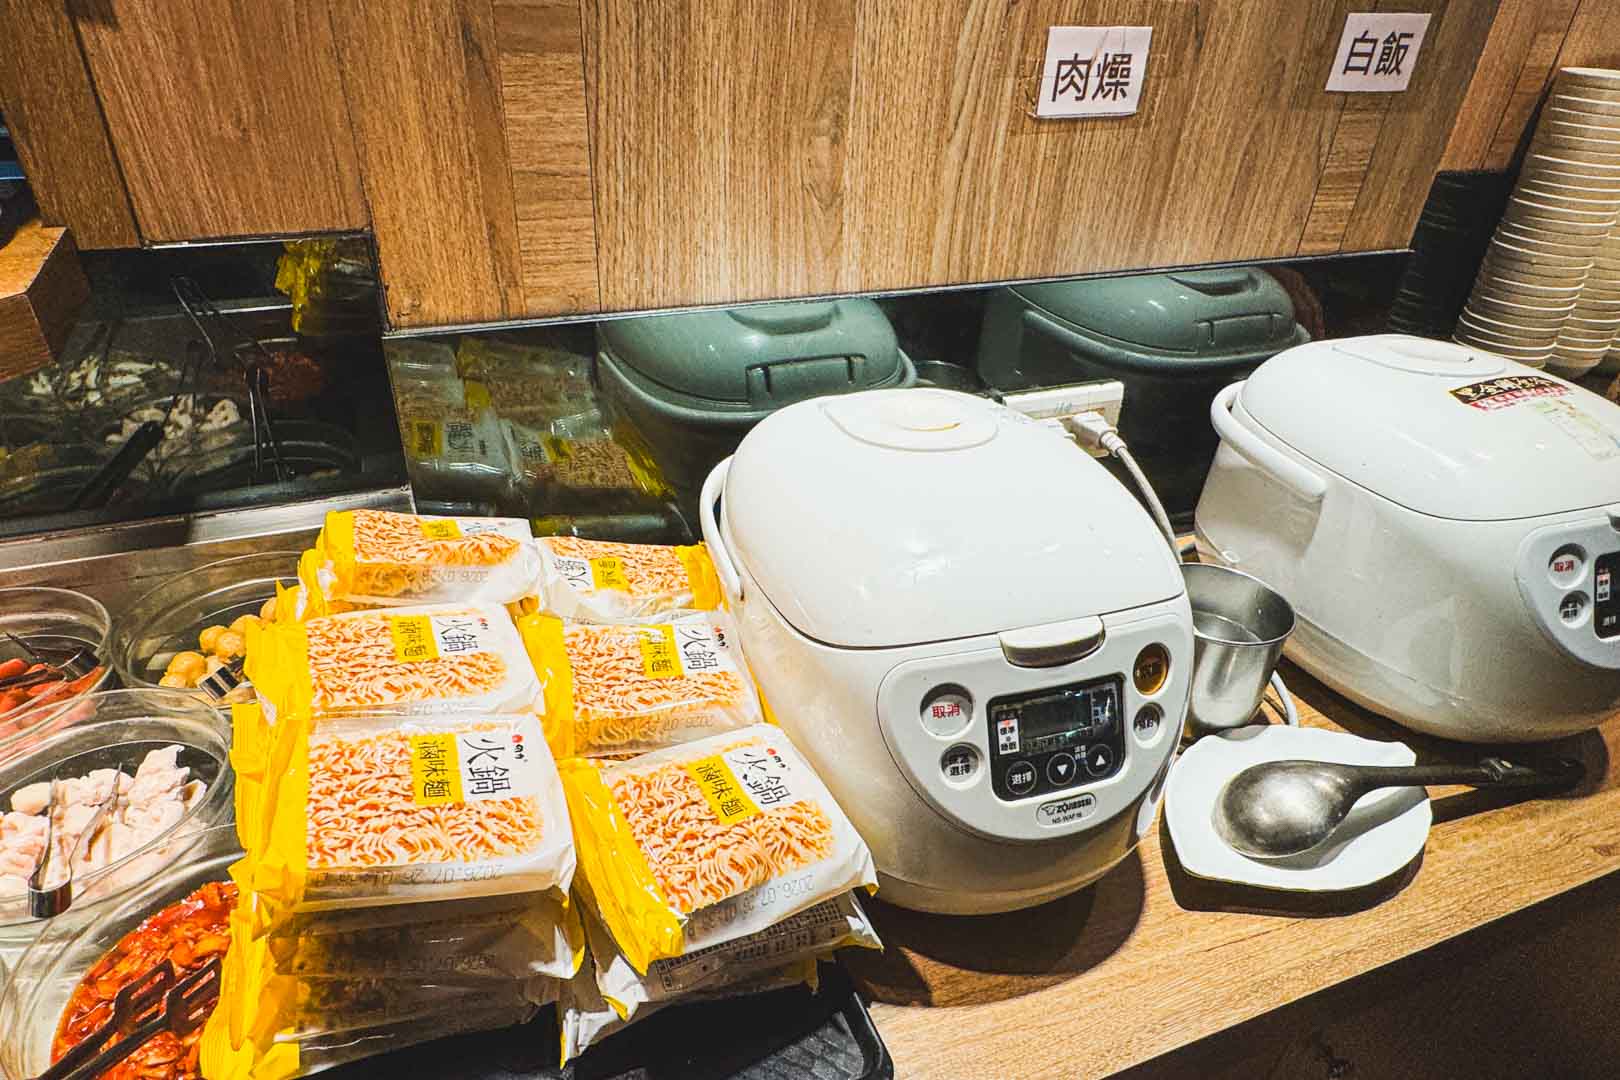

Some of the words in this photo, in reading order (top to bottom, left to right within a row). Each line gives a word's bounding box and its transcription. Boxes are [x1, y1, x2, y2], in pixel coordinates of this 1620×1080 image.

[1051, 52, 1133, 102] 肉燥
[1342, 29, 1414, 76] 白飯
[434, 619, 479, 653] 火鍋
[679, 629, 718, 670] 火鍋
[931, 703, 960, 718] 取消
[418, 741, 451, 798] 滷味麵
[463, 739, 511, 794] 火鍋
[696, 763, 744, 818] 滷味麵
[730, 753, 790, 806] 火鍋
